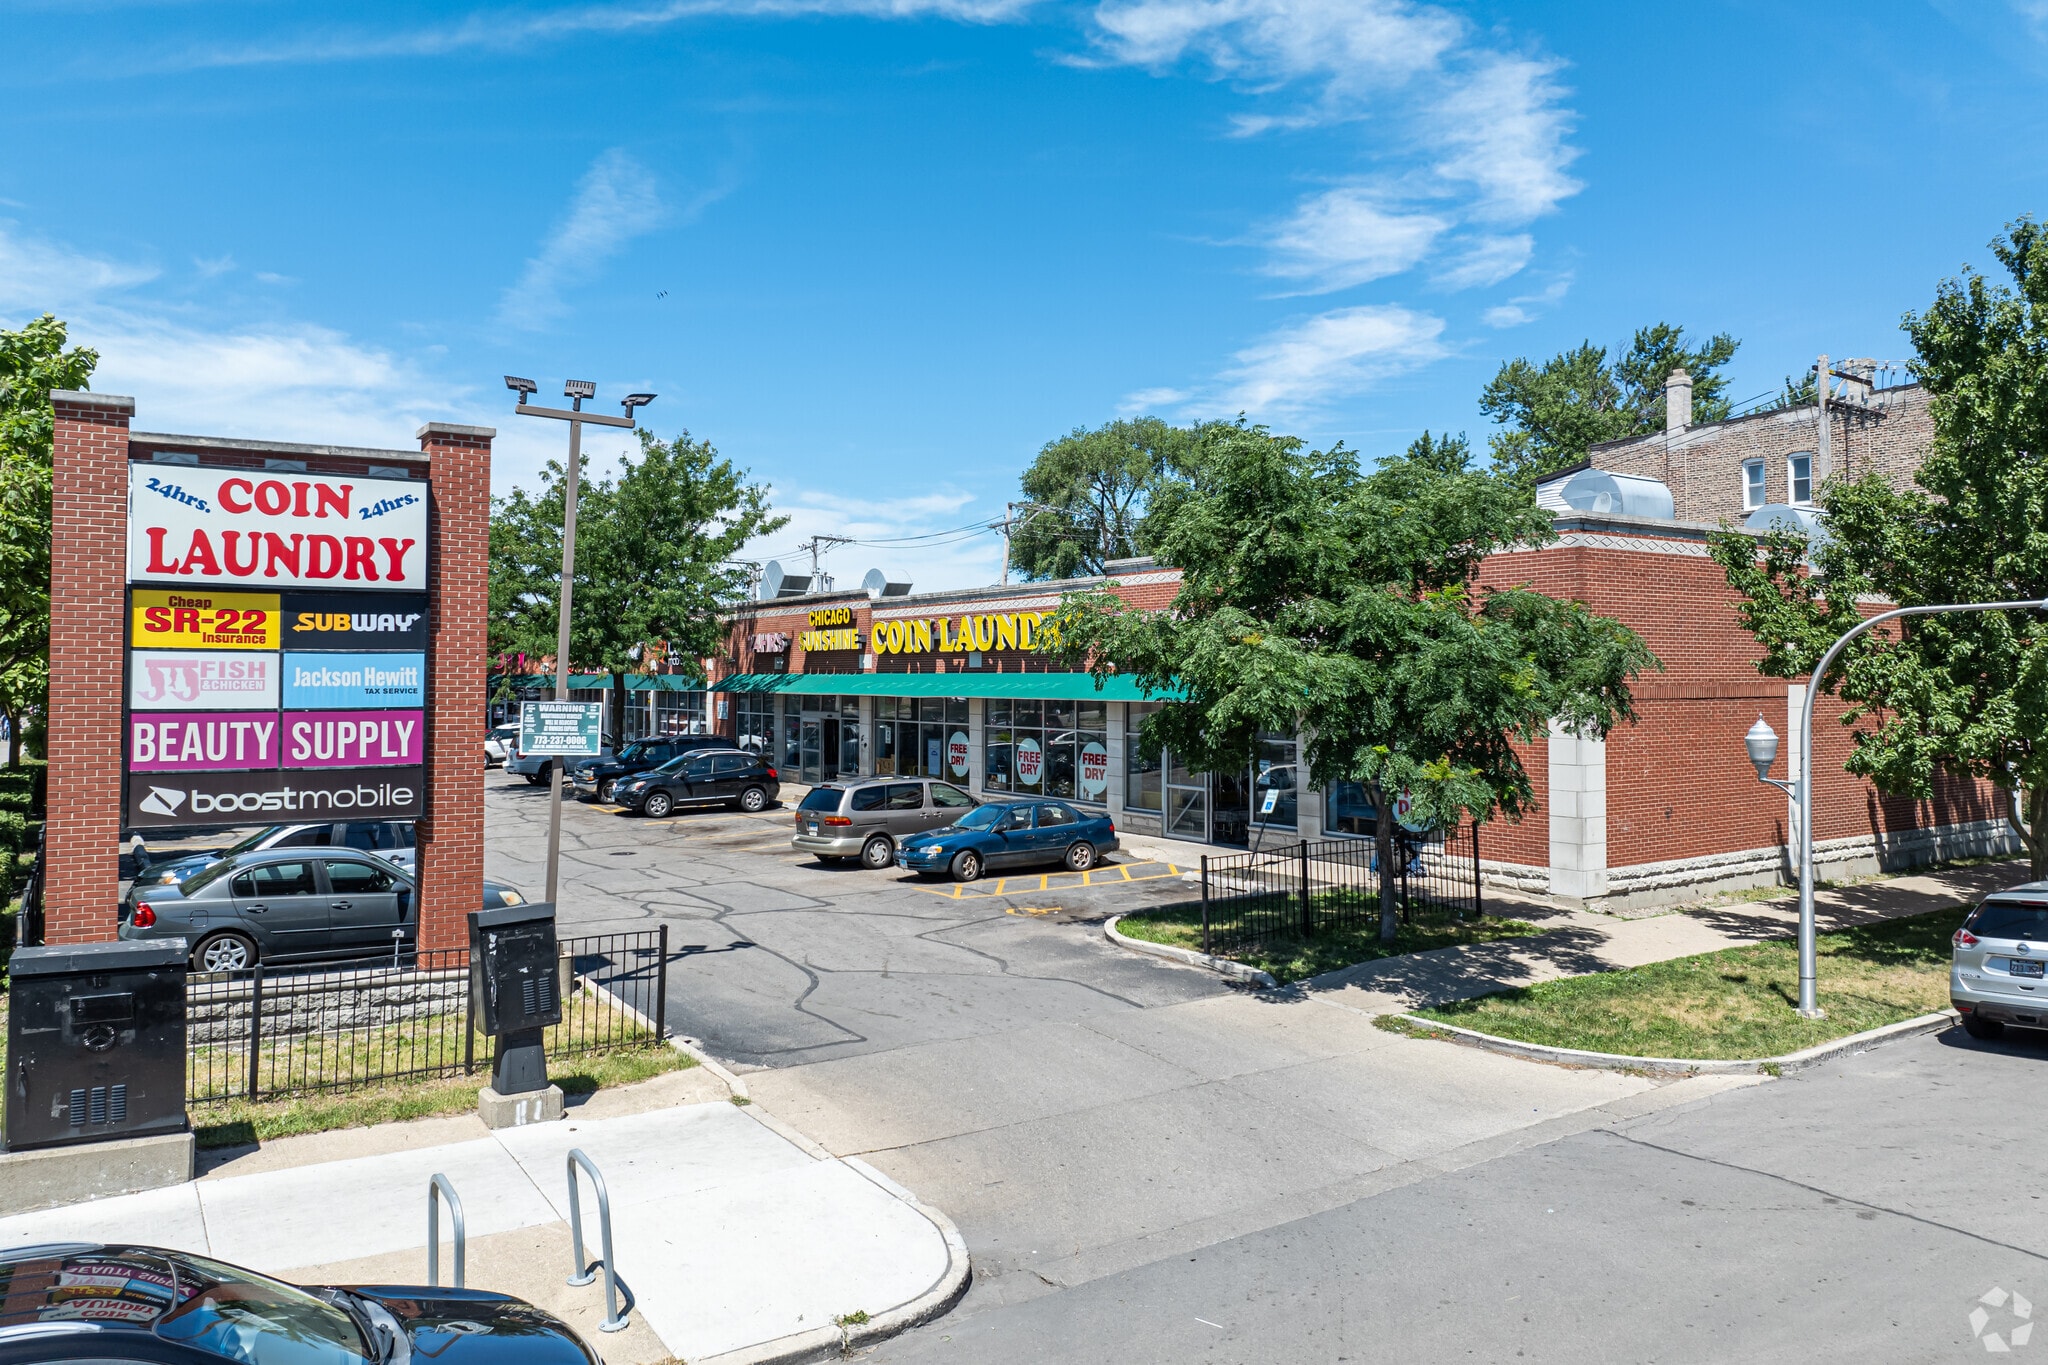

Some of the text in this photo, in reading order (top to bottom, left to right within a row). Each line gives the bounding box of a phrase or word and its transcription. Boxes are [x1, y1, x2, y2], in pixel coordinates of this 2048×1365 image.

[145, 477, 211, 513] 24hrs.
[218, 478, 353, 519] COIN
[359, 493, 419, 520] 24hrs.
[145, 527, 415, 582] LAUNDRY
[168, 596, 212, 610] Cheap
[144, 607, 267, 634] SR-22
[292, 612, 421, 632] SUBWAY
[808, 607, 851, 627] CHICAGO
[202, 632, 266, 644] Insurance
[799, 628, 859, 652] SUNSHINE
[871, 611, 1072, 654] COIN LAUND
[200, 661, 266, 679] FISH
[293, 666, 418, 688] Jackson Hewitt
[201, 680, 264, 691] &CHICKEN
[539, 704, 586, 713] WARNING
[133, 720, 415, 763] BEAUTY SUPPLY
[950, 743, 968, 754] FREE
[951, 755, 966, 766] DRY
[1018, 750, 1041, 763] FREE
[1082, 752, 1107, 766] FREE
[1020, 763, 1039, 775] DRY
[1084, 767, 1106, 781] DRY
